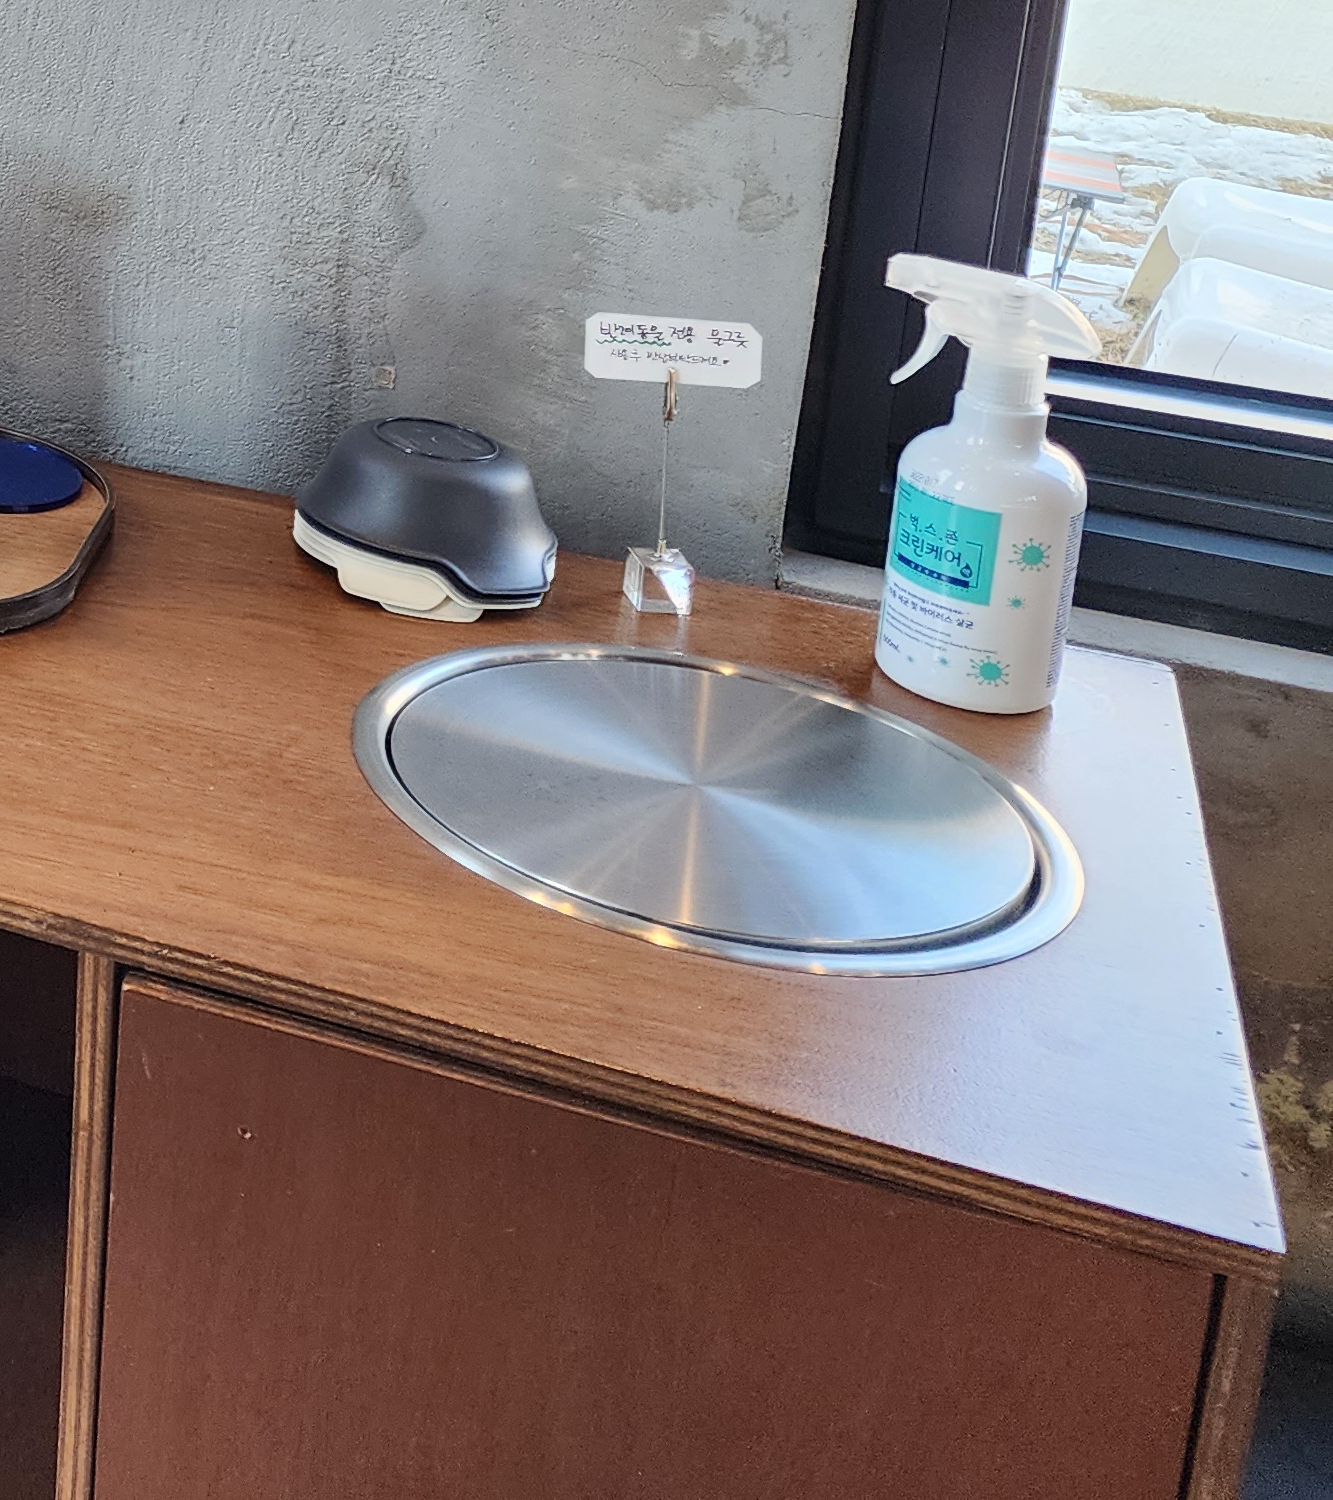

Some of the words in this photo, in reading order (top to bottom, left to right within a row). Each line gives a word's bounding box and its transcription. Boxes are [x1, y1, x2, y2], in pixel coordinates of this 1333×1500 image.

[667, 326, 695, 344] 전용
[706, 328, 749, 348] 물그릇
[899, 528, 962, 567] 크린케어
[919, 605, 953, 624] 바이러스
